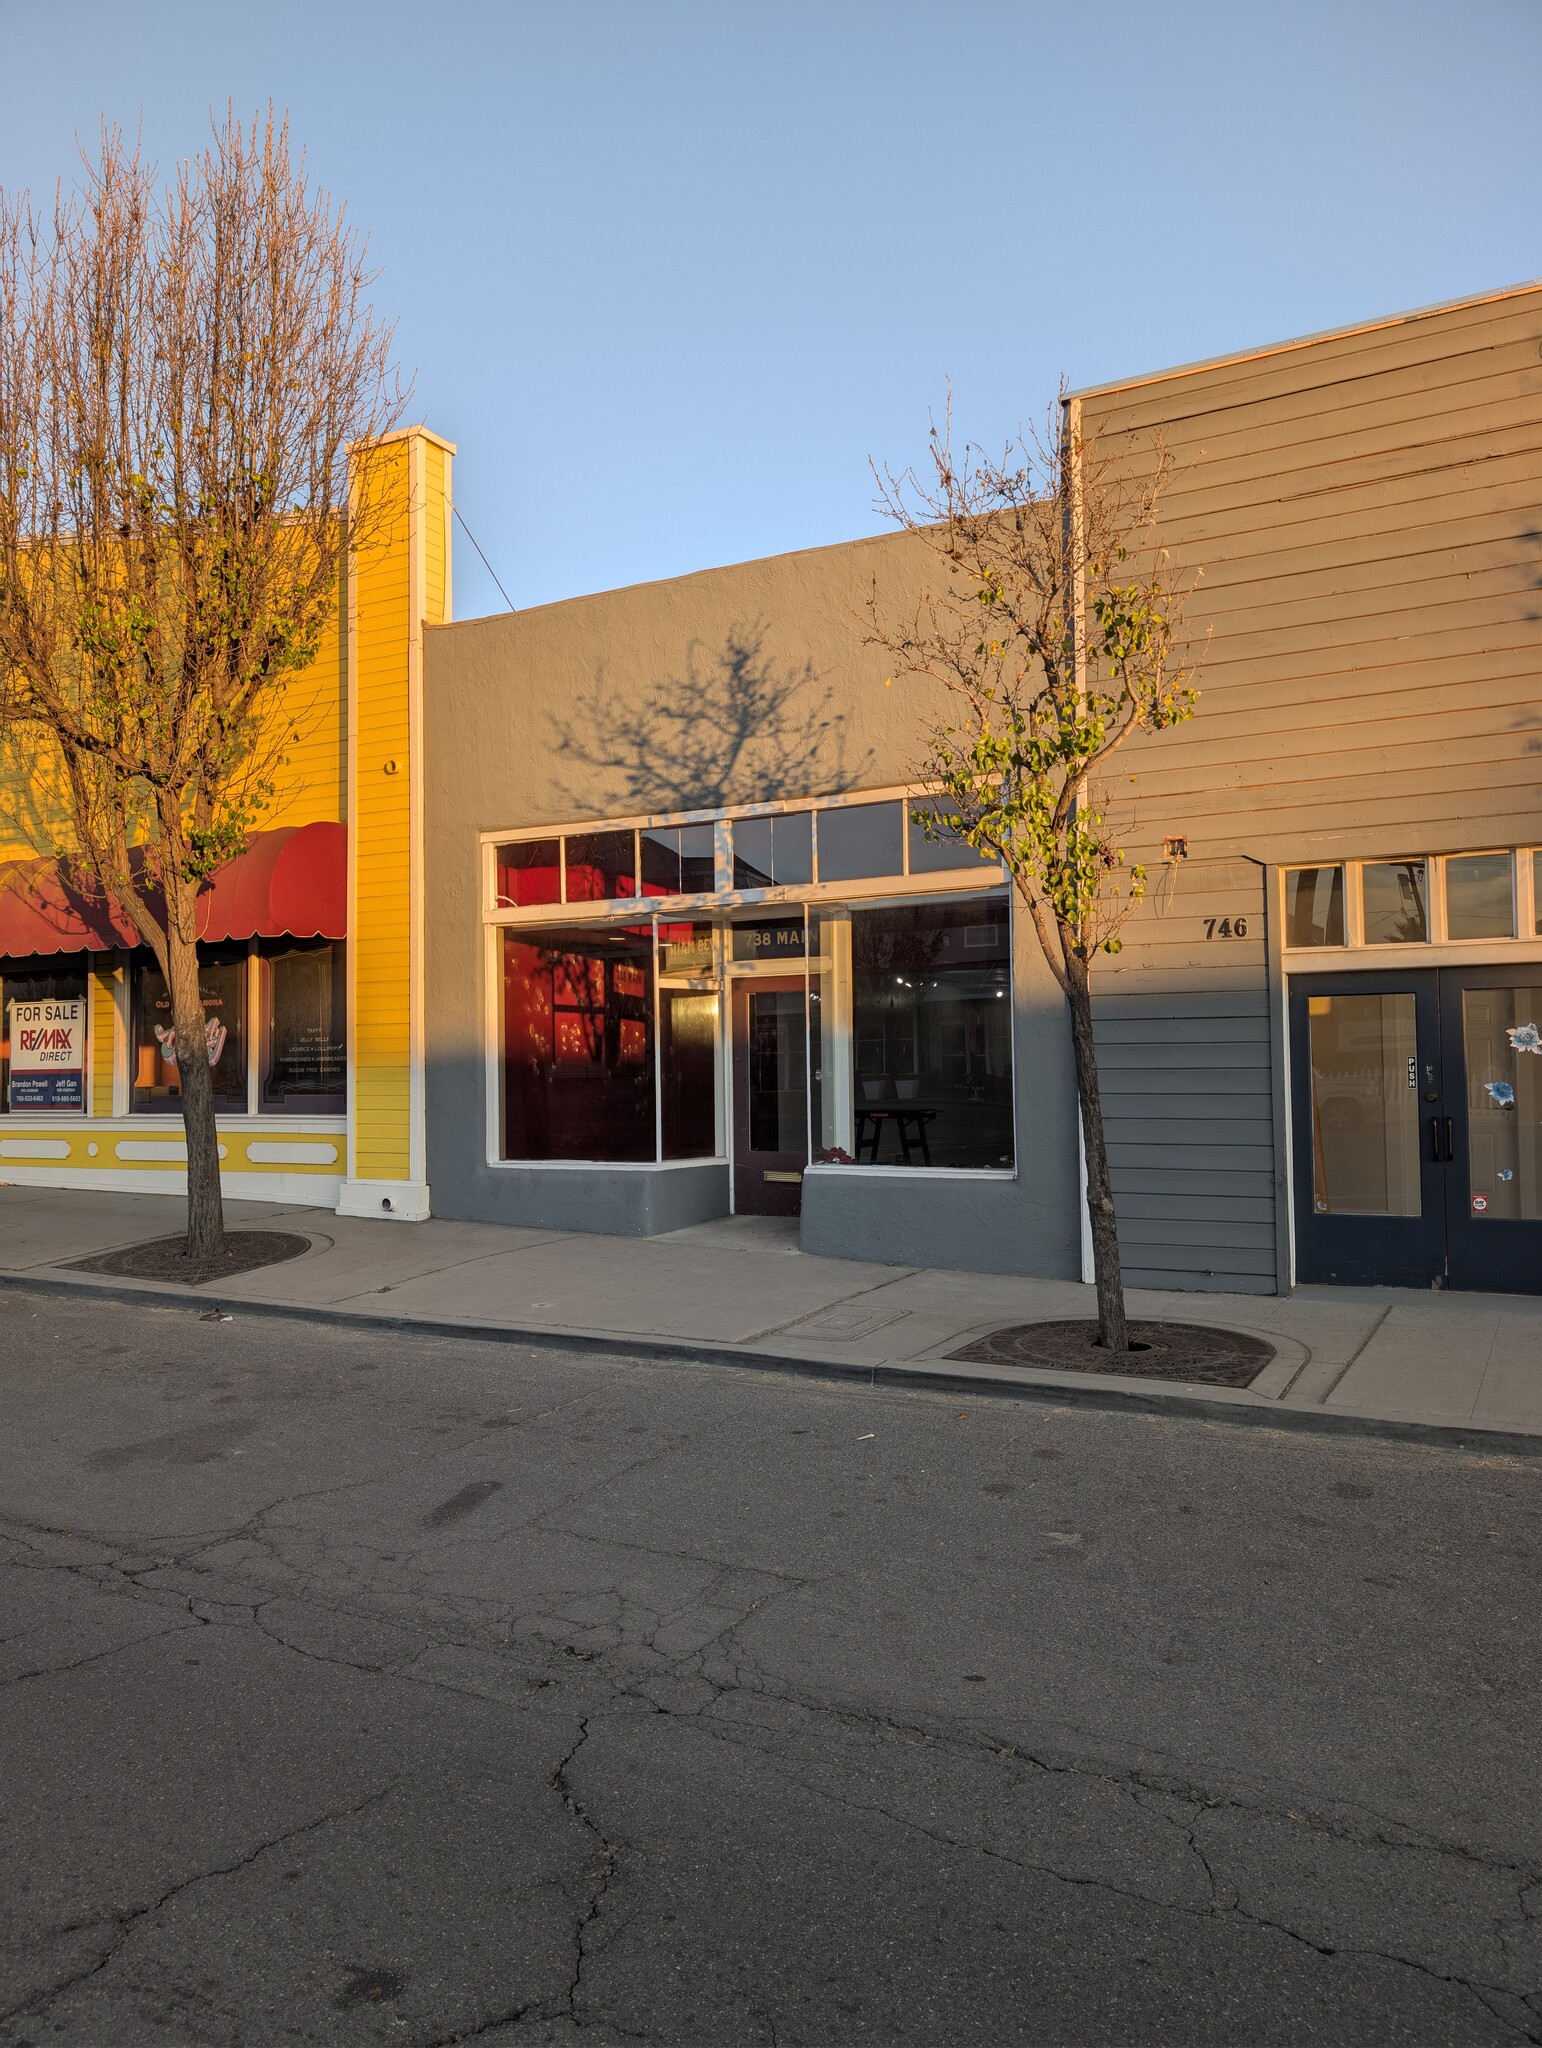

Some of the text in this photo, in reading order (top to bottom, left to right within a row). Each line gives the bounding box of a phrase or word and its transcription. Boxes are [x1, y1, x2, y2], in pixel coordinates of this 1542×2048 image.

[1203, 917, 1248, 940] 746
[743, 929, 819, 947] 738 MAIN
[155, 1000, 170, 1009] OLD
[16, 1005, 78, 1022] FOR SALE
[20, 1028, 73, 1051] RE/MAX
[40, 1051, 73, 1062] DIRECT
[1408, 1057, 1416, 1088] PUSH
[11, 1080, 49, 1088] Brandon Powell
[55, 1079, 78, 1088] Jeff Gan
